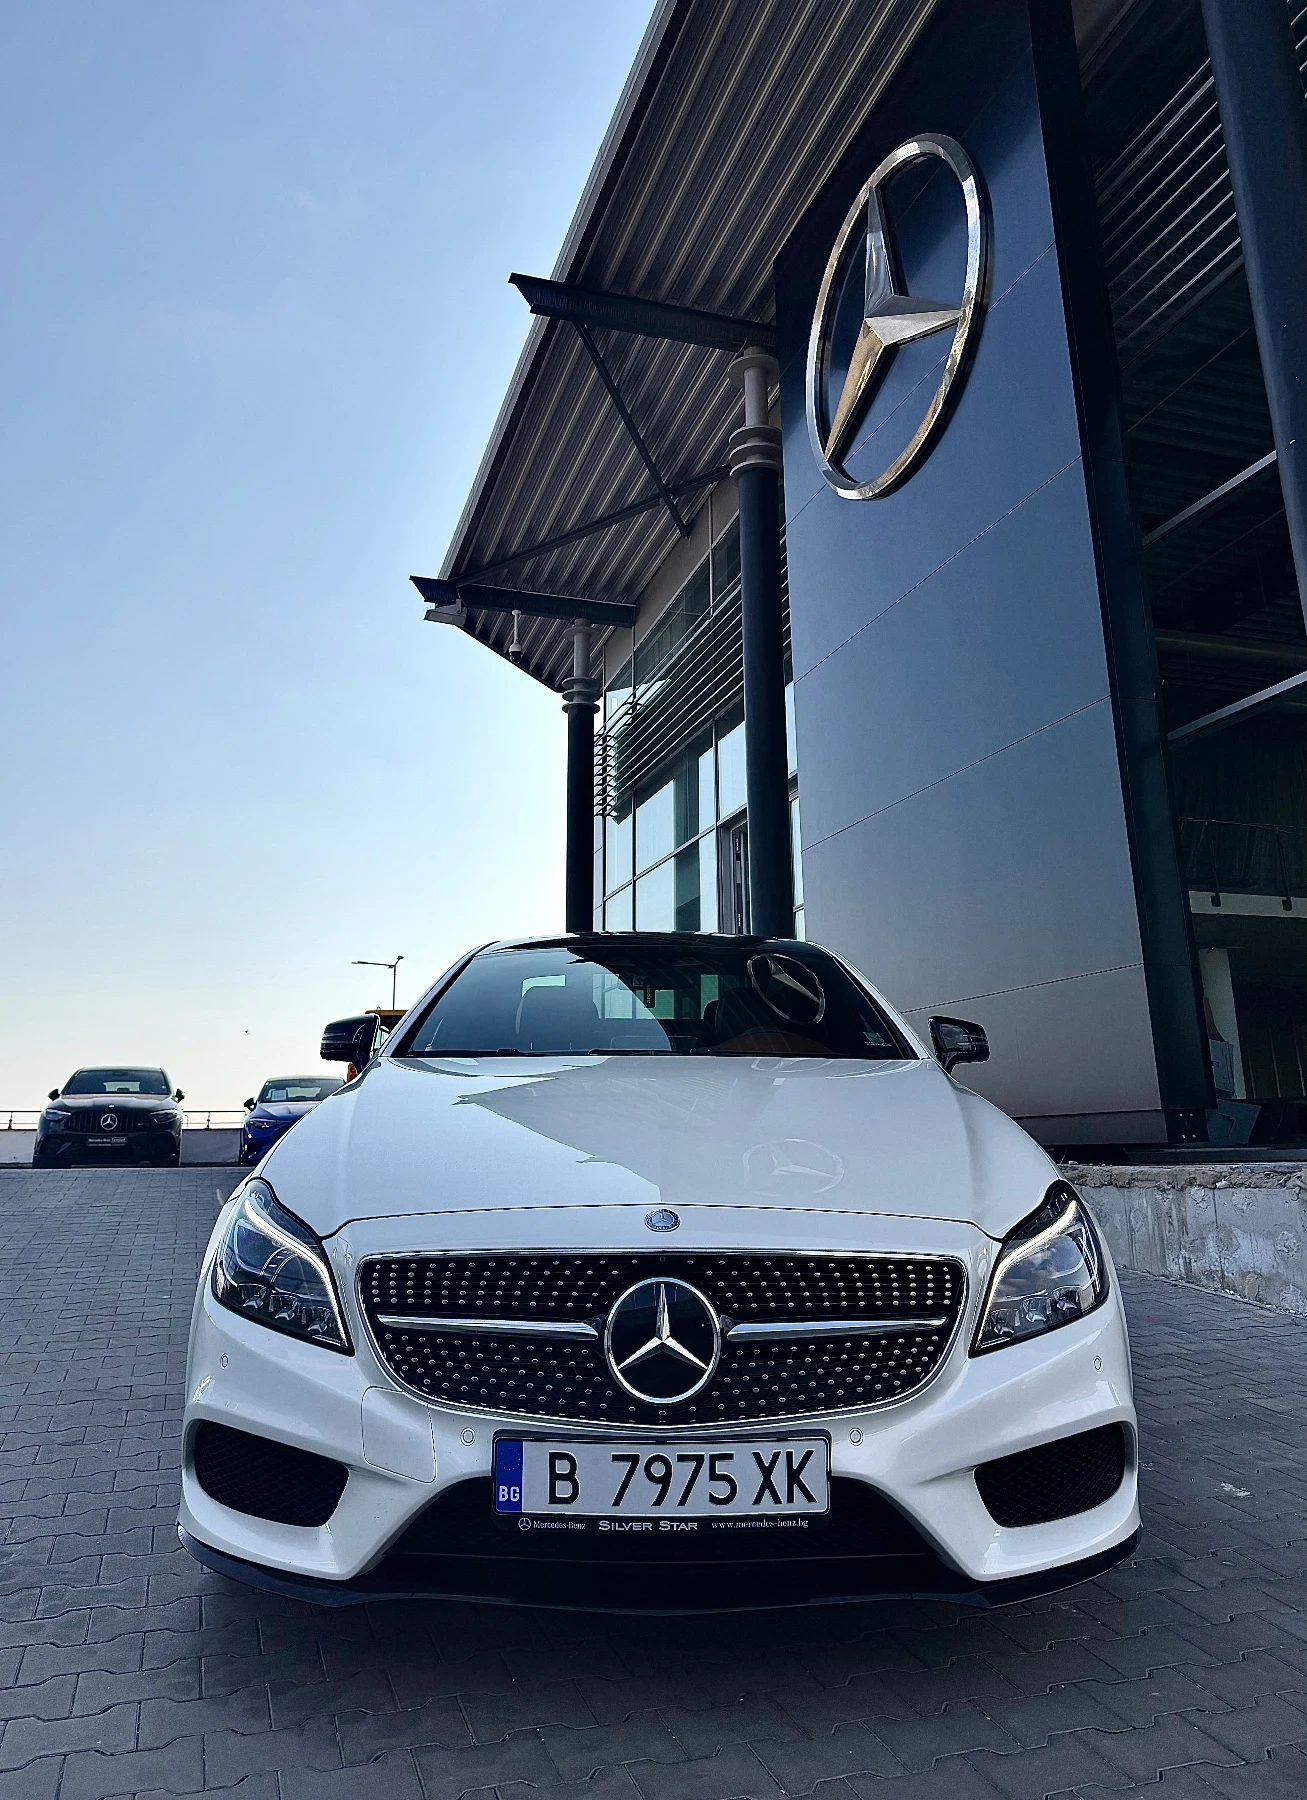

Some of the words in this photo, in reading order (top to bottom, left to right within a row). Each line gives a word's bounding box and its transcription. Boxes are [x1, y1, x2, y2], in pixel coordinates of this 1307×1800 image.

[547, 1450, 581, 1505] B
[609, 1451, 739, 1507] 7975
[751, 1449, 818, 1505] XK
[498, 1485, 520, 1502] BG
[532, 1520, 587, 1530] Mercedes-Benz
[598, 1519, 654, 1532] SILVER
[658, 1520, 699, 1532] STAR
[710, 1517, 810, 1529] www.mercedes-benz.bg
